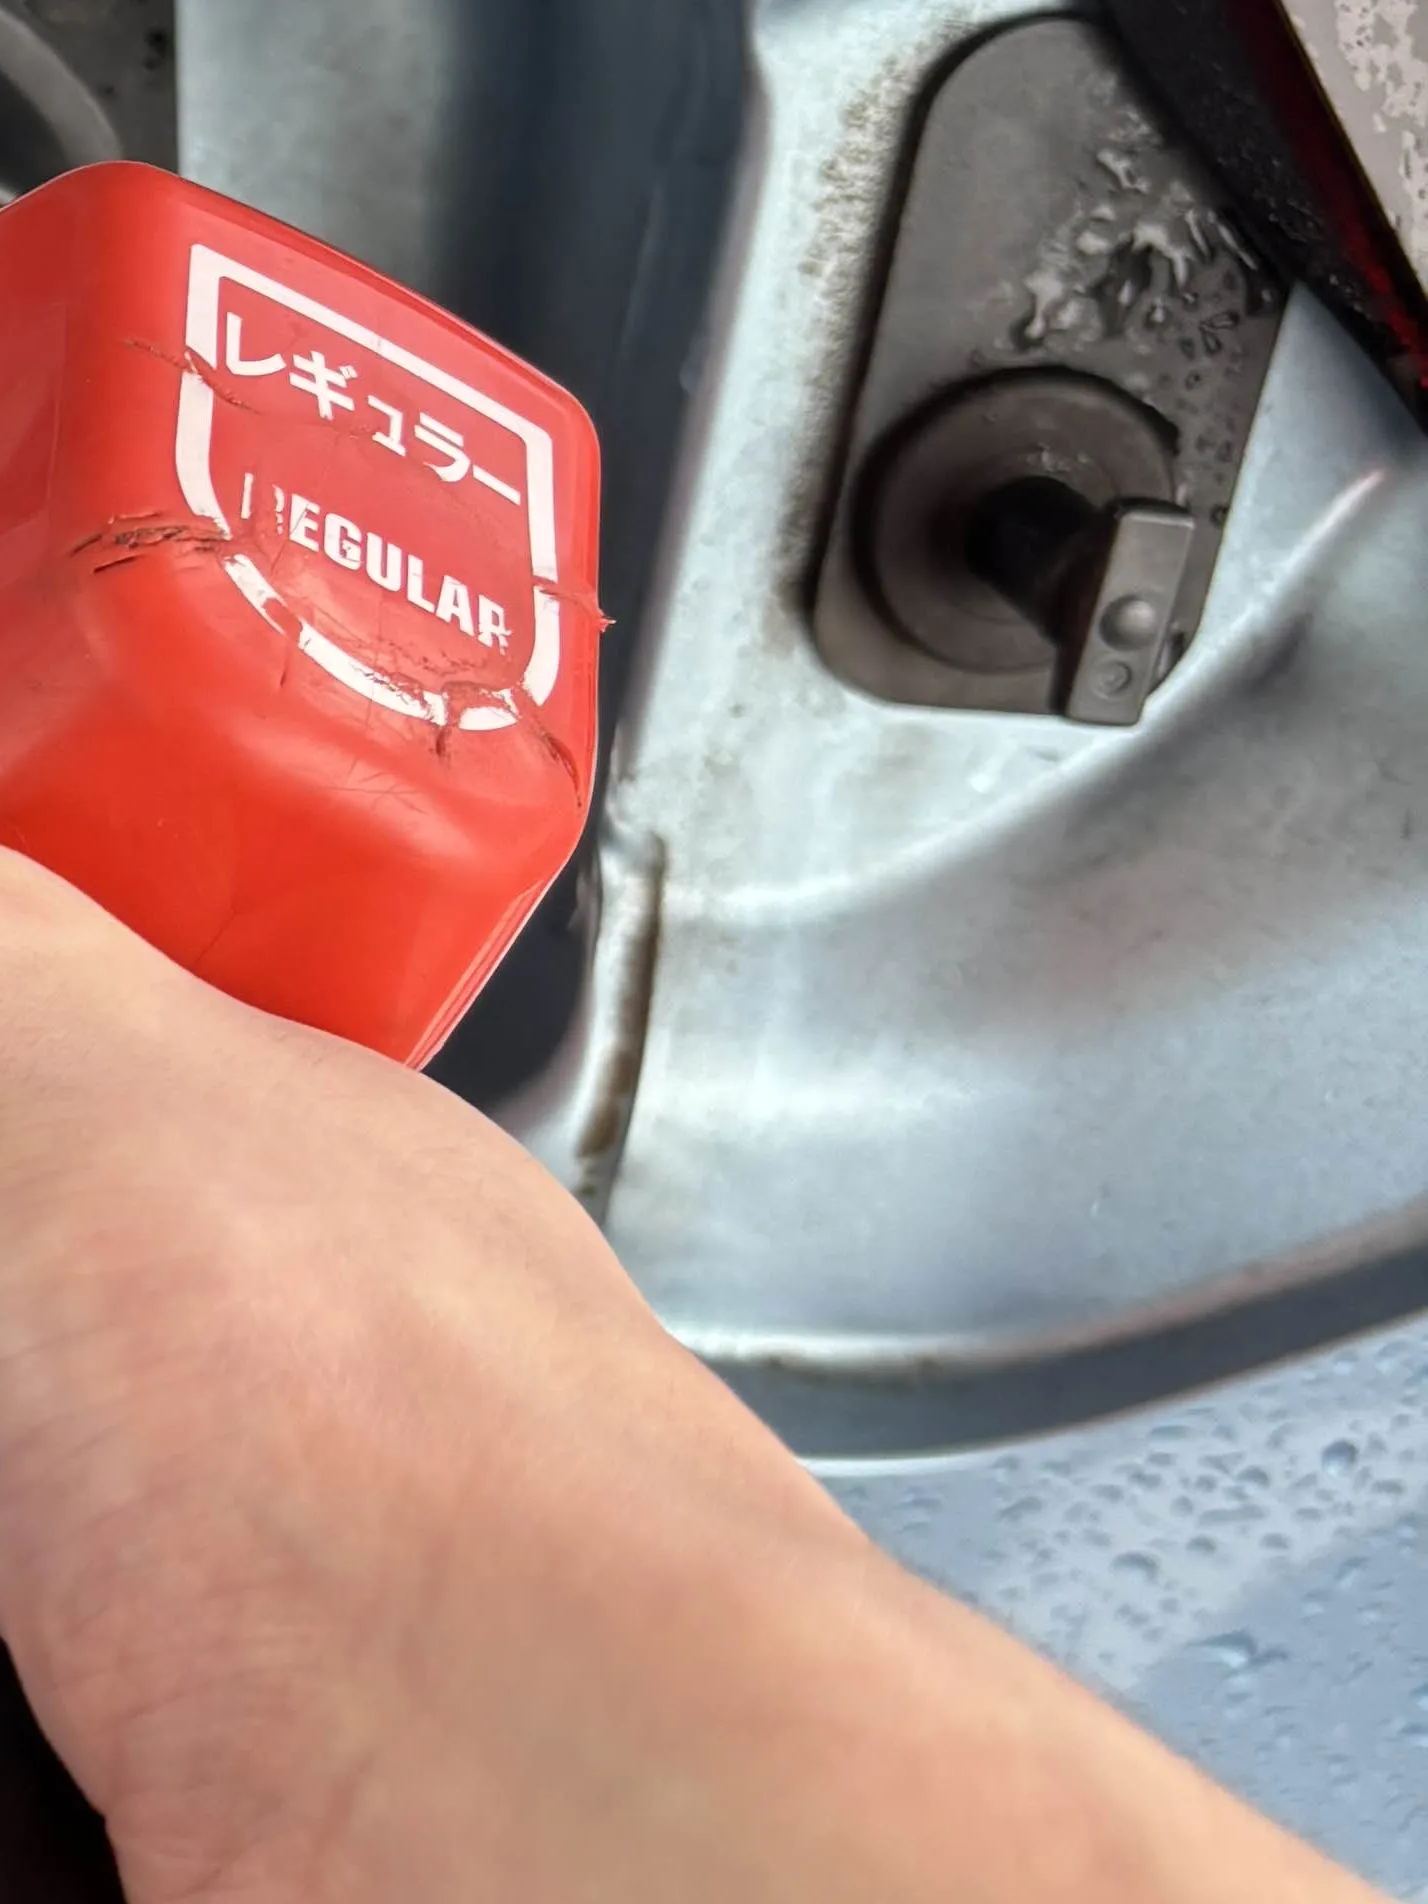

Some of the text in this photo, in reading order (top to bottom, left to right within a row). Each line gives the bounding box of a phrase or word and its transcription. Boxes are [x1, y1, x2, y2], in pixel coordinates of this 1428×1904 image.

[224, 311, 522, 507] レギュラー
